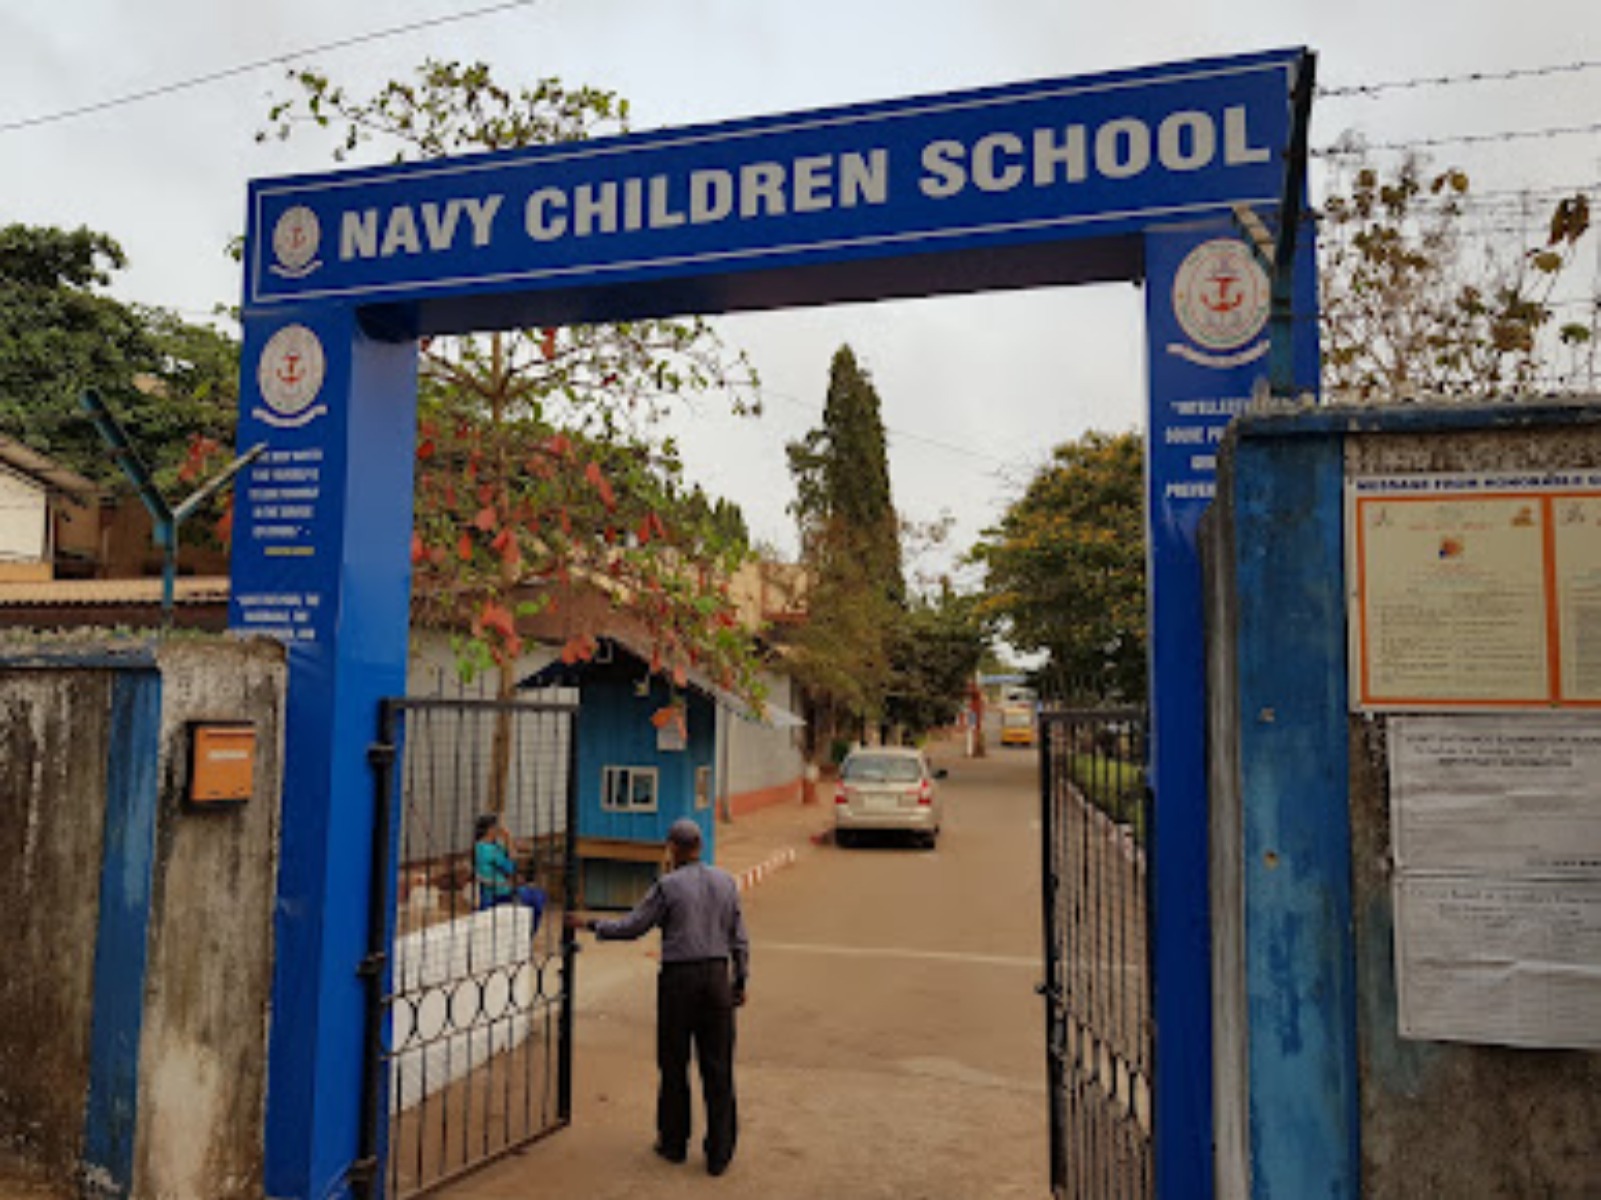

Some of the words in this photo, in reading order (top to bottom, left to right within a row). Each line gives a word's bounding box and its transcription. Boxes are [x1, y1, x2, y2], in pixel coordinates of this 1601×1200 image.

[339, 194, 504, 261] NAVY
[524, 147, 889, 242] CHILDREN
[918, 105, 1271, 199] SCHOOL
